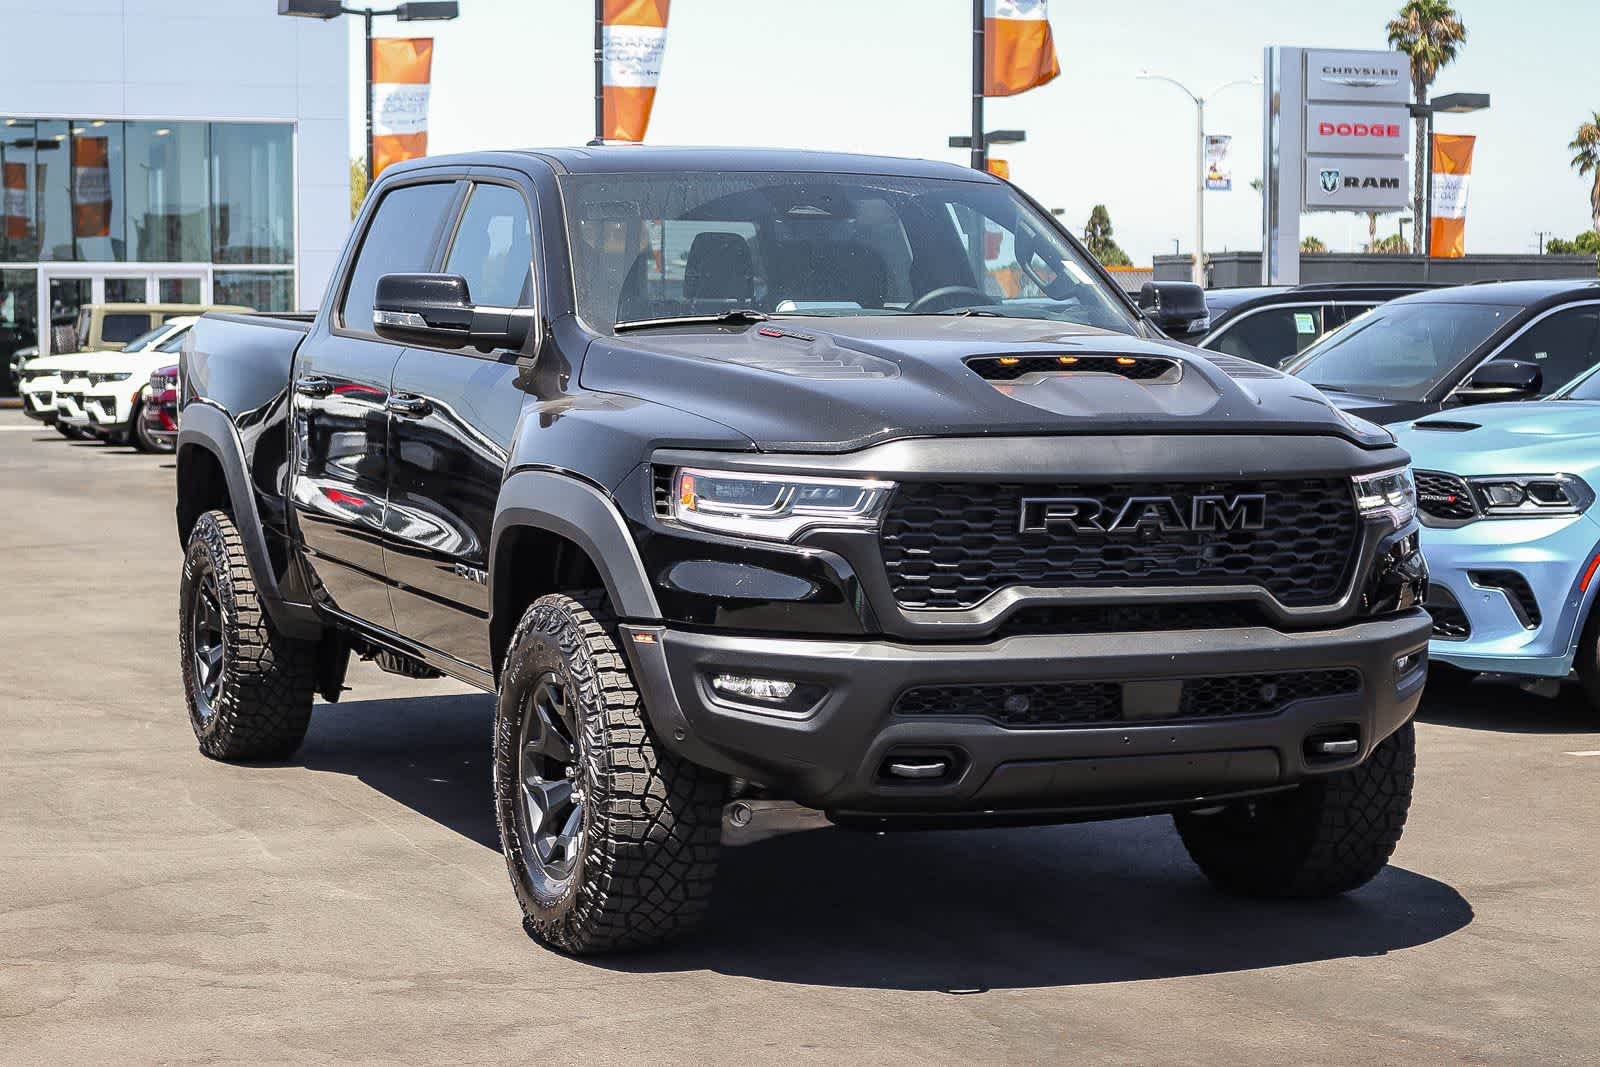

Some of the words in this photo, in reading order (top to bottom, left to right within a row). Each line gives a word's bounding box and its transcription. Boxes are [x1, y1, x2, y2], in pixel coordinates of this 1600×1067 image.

[1322, 66, 1398, 76] CHRYSLER
[1319, 122, 1400, 137] DODGE
[1344, 176, 1399, 188] RAM
[1019, 495, 1266, 532] RAM
